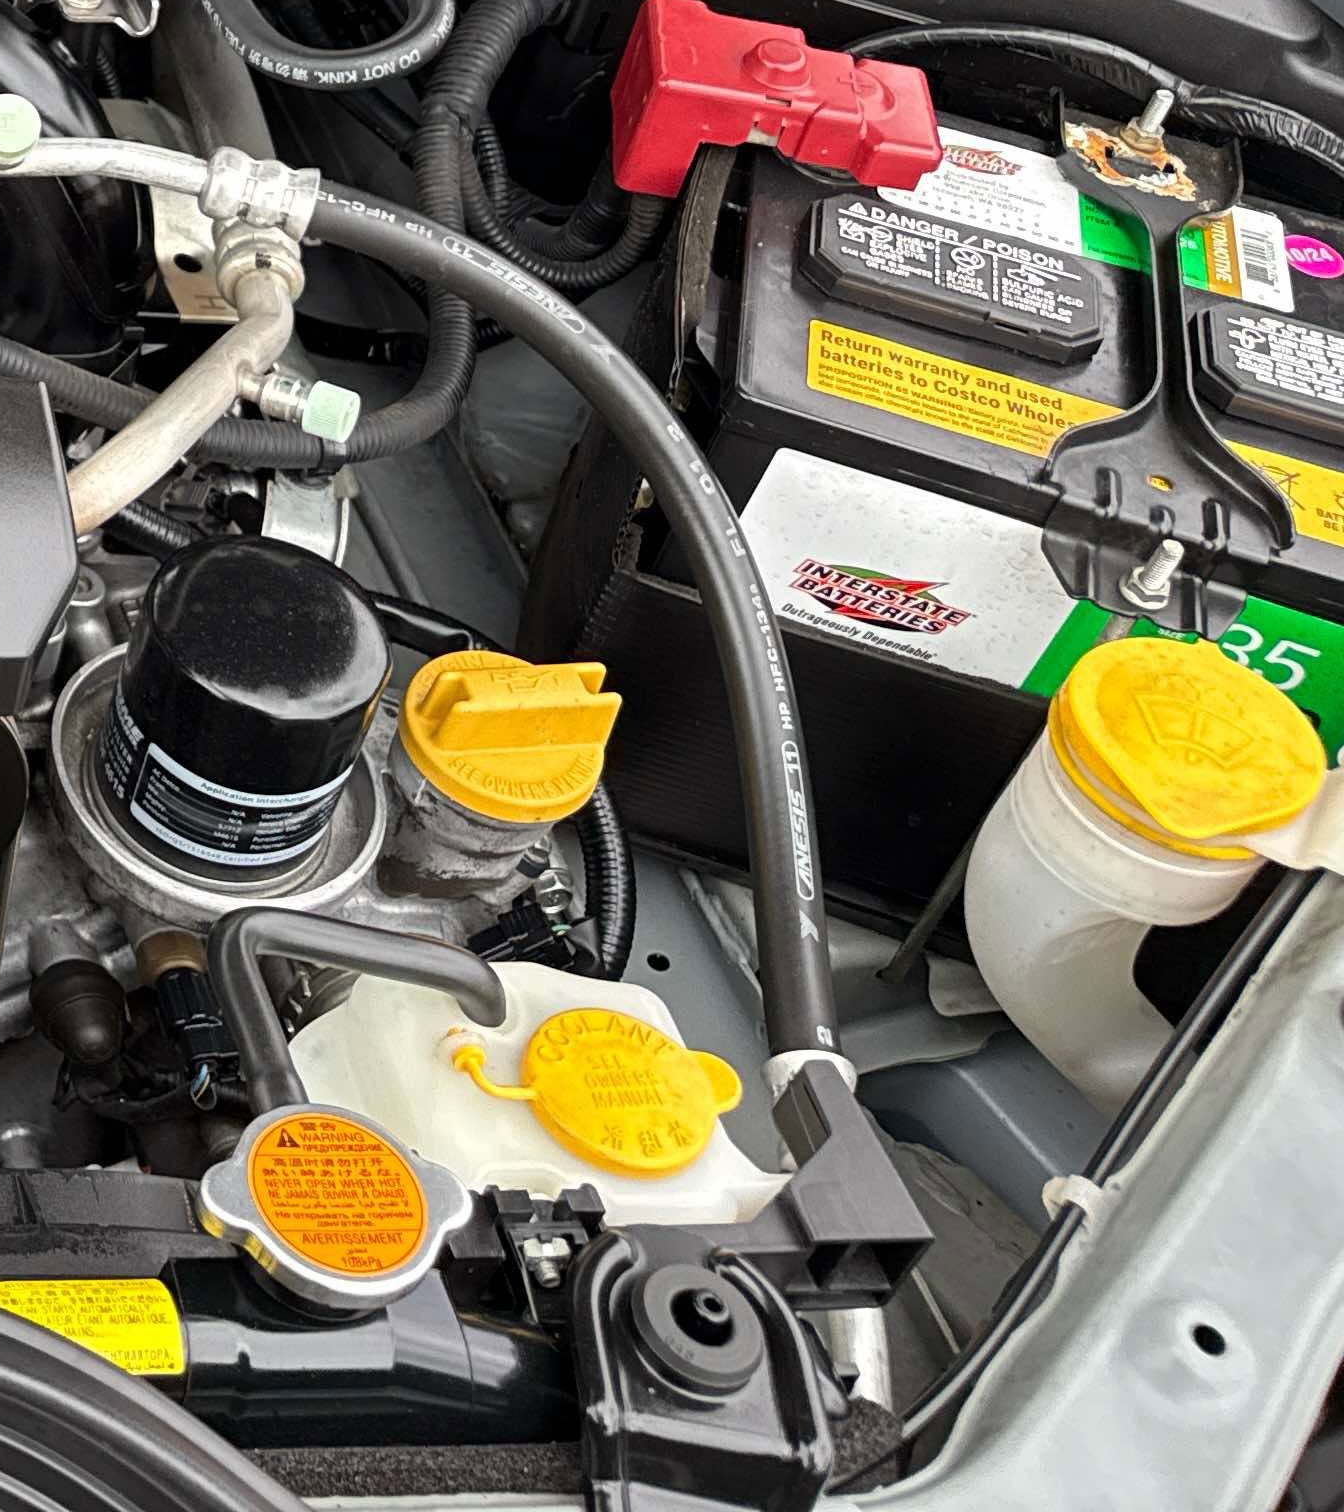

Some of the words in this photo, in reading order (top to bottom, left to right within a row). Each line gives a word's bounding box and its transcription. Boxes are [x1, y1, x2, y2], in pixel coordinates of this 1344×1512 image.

[399, 47, 422, 69] DO
[313, 70, 358, 84] KINK.
[363, 62, 396, 81] NOT
[405, 221, 433, 240] HP
[870, 207, 959, 242] DANGER
[960, 234, 978, 247] /
[982, 239, 1063, 271] POISON
[1211, 219, 1234, 284] UTOMOTIVE
[956, 265, 976, 277] NO
[1002, 277, 1054, 300] SULFURIC
[1057, 292, 1084, 308] ACID
[818, 363, 893, 389] PROPOSITION
[896, 384, 909, 394] 65
[820, 345, 904, 381] batteries
[909, 371, 928, 388] to
[934, 380, 1000, 410] Costco
[821, 328, 882, 358] Return
[889, 349, 970, 386] warranty
[976, 375, 1010, 396] and
[1017, 386, 1063, 411] used
[1324, 520, 1338, 532] BE
[797, 577, 945, 634] BATTERIES
[802, 562, 966, 626] INTERSTATE
[750, 584, 786, 692] HFC-134a
[781, 602, 862, 637] Outrageously
[862, 631, 933, 660] Dependable
[1222, 623, 1322, 691] 35
[778, 701, 794, 731] HP
[449, 756, 481, 782] SEE
[551, 751, 597, 796] MANUAL
[201, 781, 255, 804] Application
[537, 1015, 676, 1063] COOLANT
[587, 1053, 626, 1070] SEE
[591, 1088, 664, 1109] MANUAL
[299, 1132, 365, 1143] WARNING
[264, 1178, 301, 1188] NEVER
[306, 1178, 336, 1189] OPEN
[340, 1178, 374, 1189] WHEN
[268, 1189, 282, 1199] NE
[286, 1189, 320, 1200] JAMAIS
[323, 1189, 357, 1200] OUVRIR
[302, 1232, 404, 1245] AVERTISSEMENT
[43, 1304, 76, 1315] STARTS
[77, 1313, 105, 1324] ÉTANT
